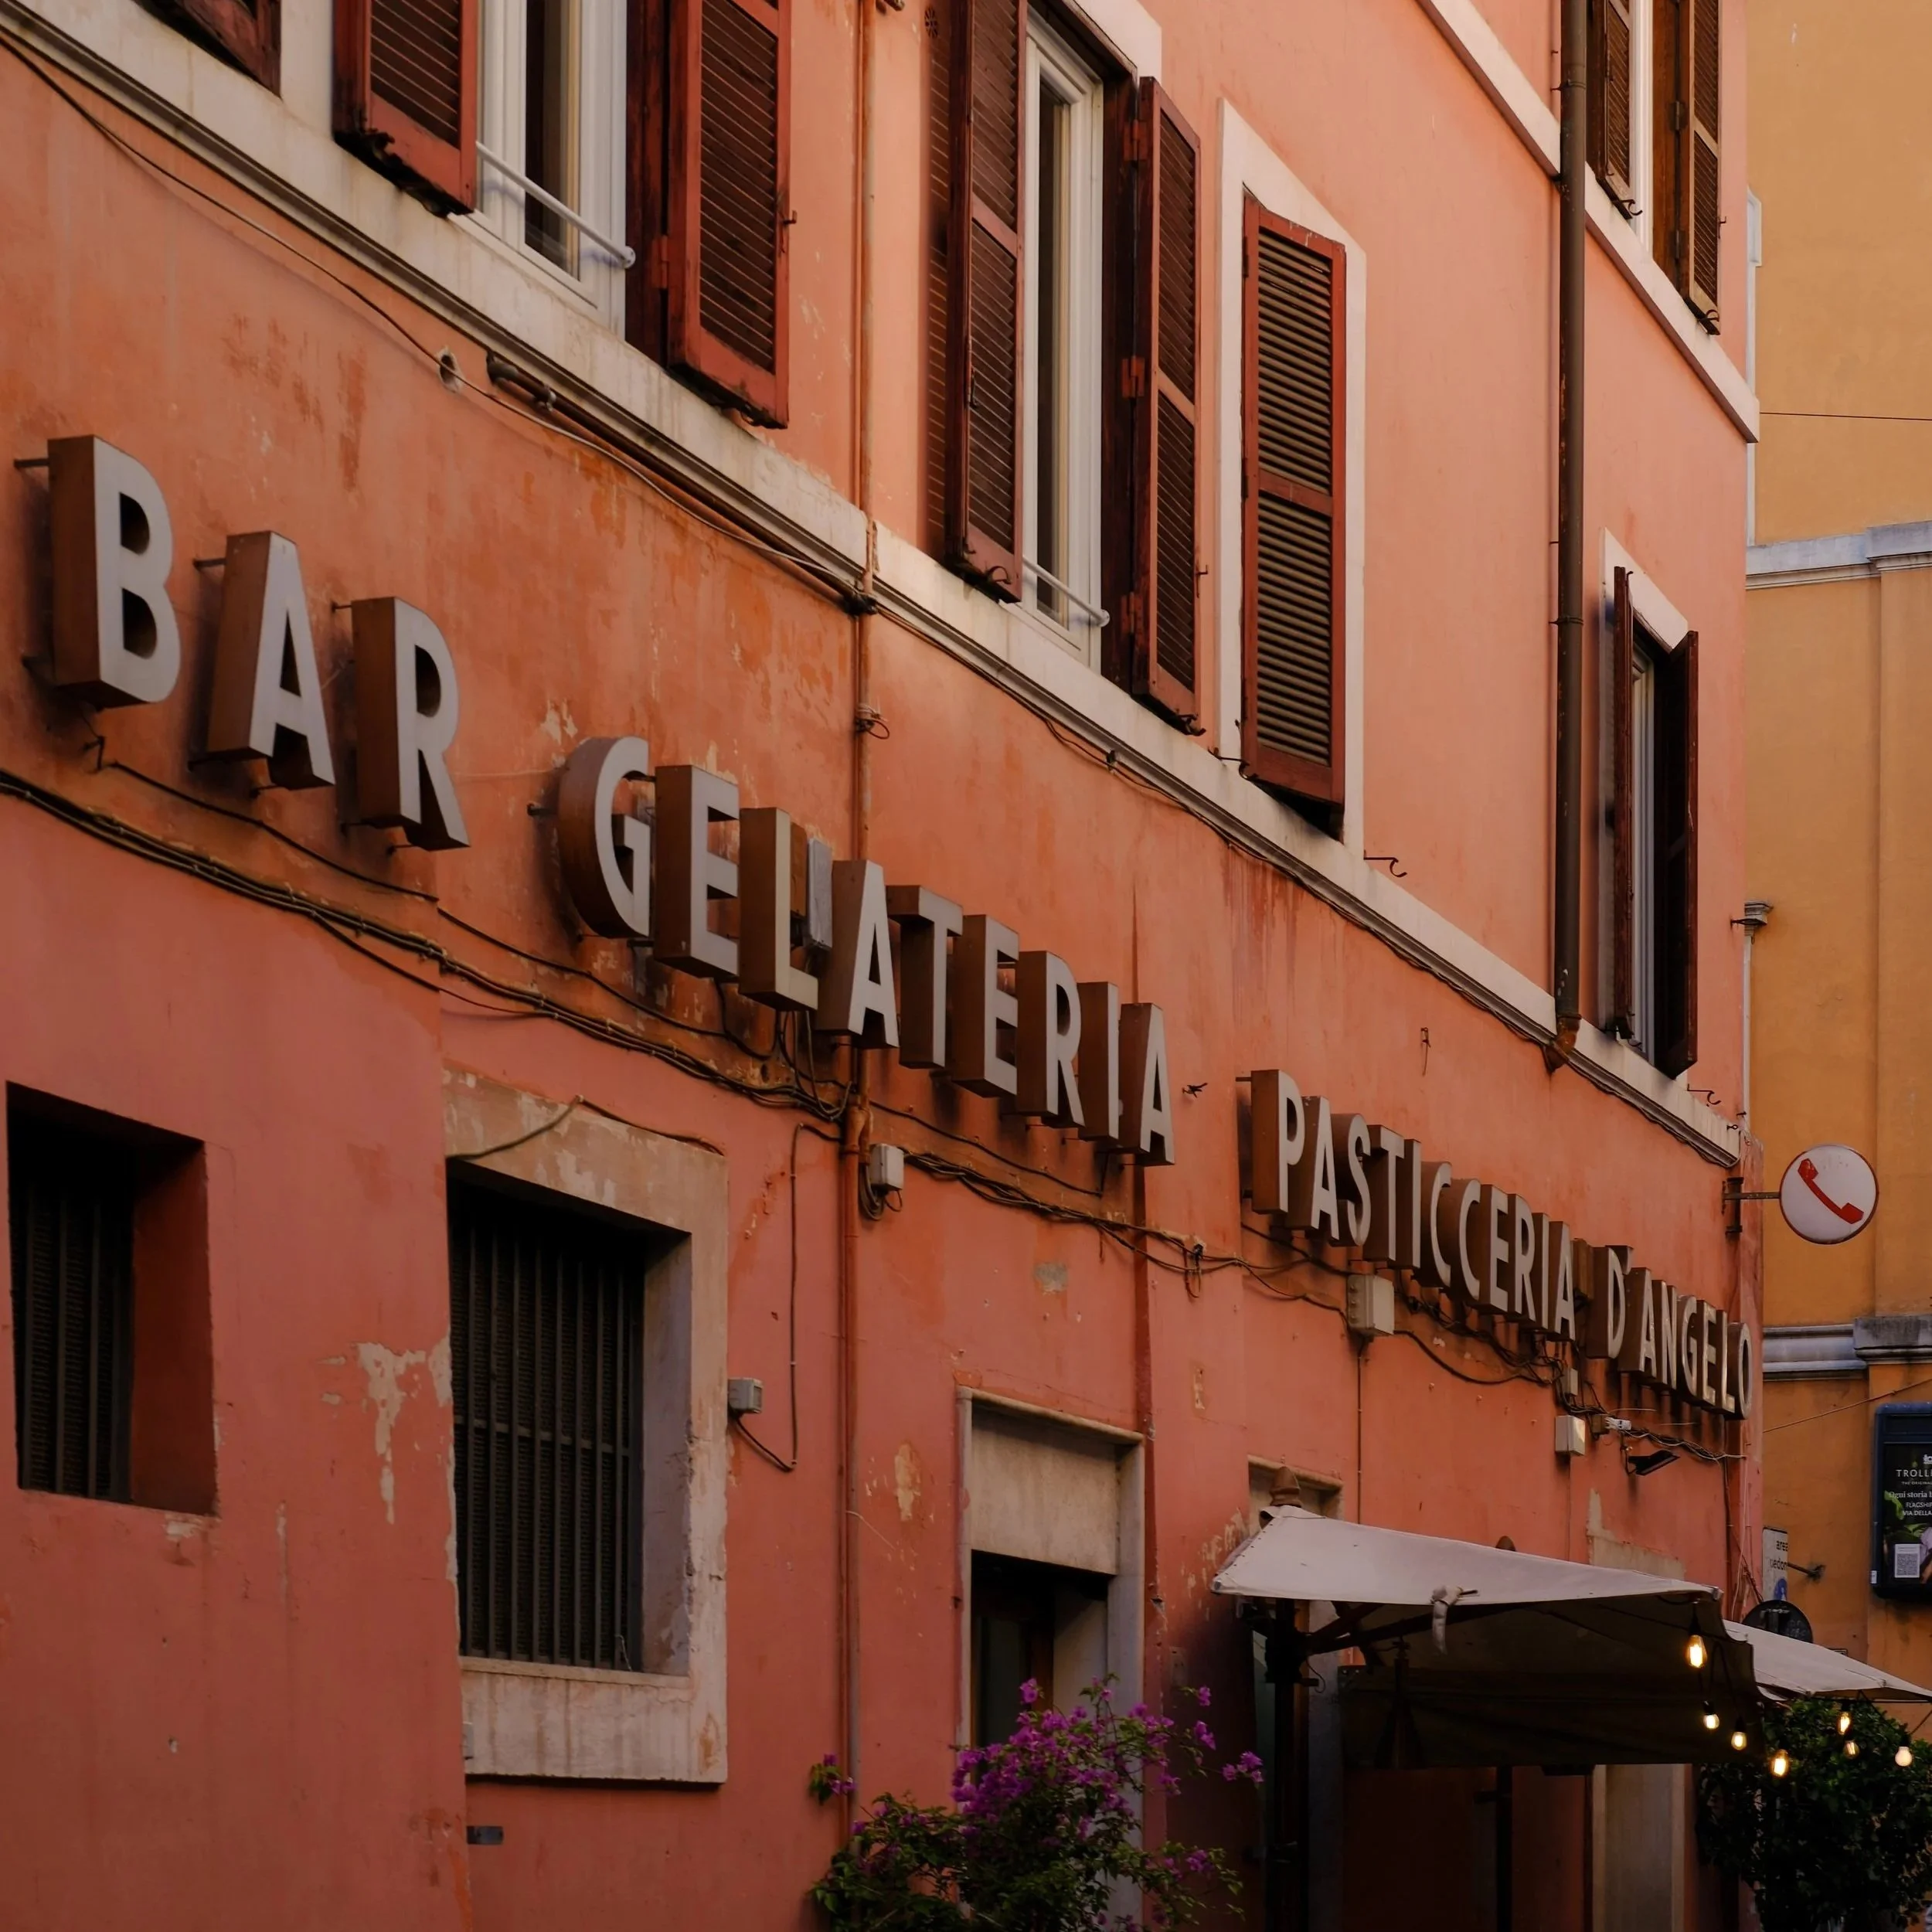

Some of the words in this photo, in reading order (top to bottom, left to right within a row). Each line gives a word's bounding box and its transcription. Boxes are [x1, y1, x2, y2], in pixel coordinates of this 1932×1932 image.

[92, 434, 471, 848] BAR
[594, 735, 1175, 1166] GELATERIA
[1277, 1069, 1576, 1342] PASTICCERIA
[1607, 1246, 1753, 1420] D'ANGELO
